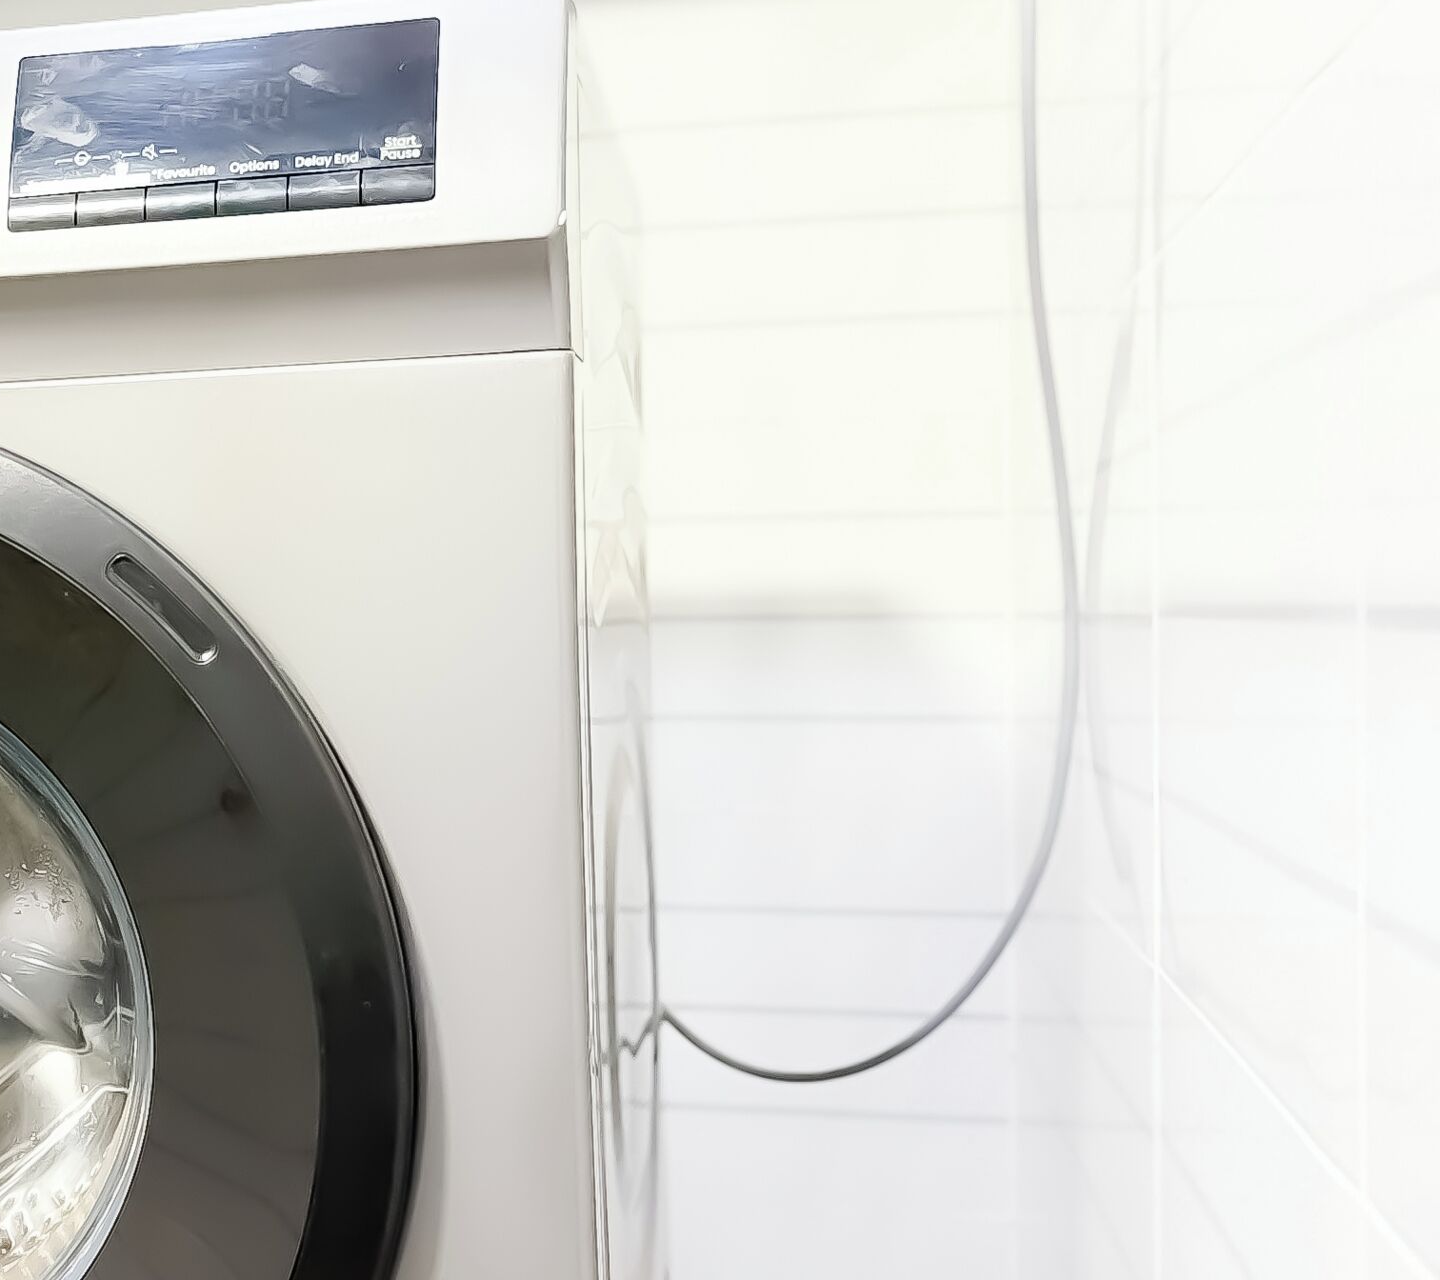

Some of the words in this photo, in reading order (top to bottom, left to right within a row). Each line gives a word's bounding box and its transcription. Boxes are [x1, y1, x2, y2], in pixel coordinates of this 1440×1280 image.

[384, 135, 417, 147] Start
[380, 148, 421, 160] Pause
[229, 158, 280, 174] Options
[294, 155, 332, 169] Delay
[334, 152, 359, 165] End
